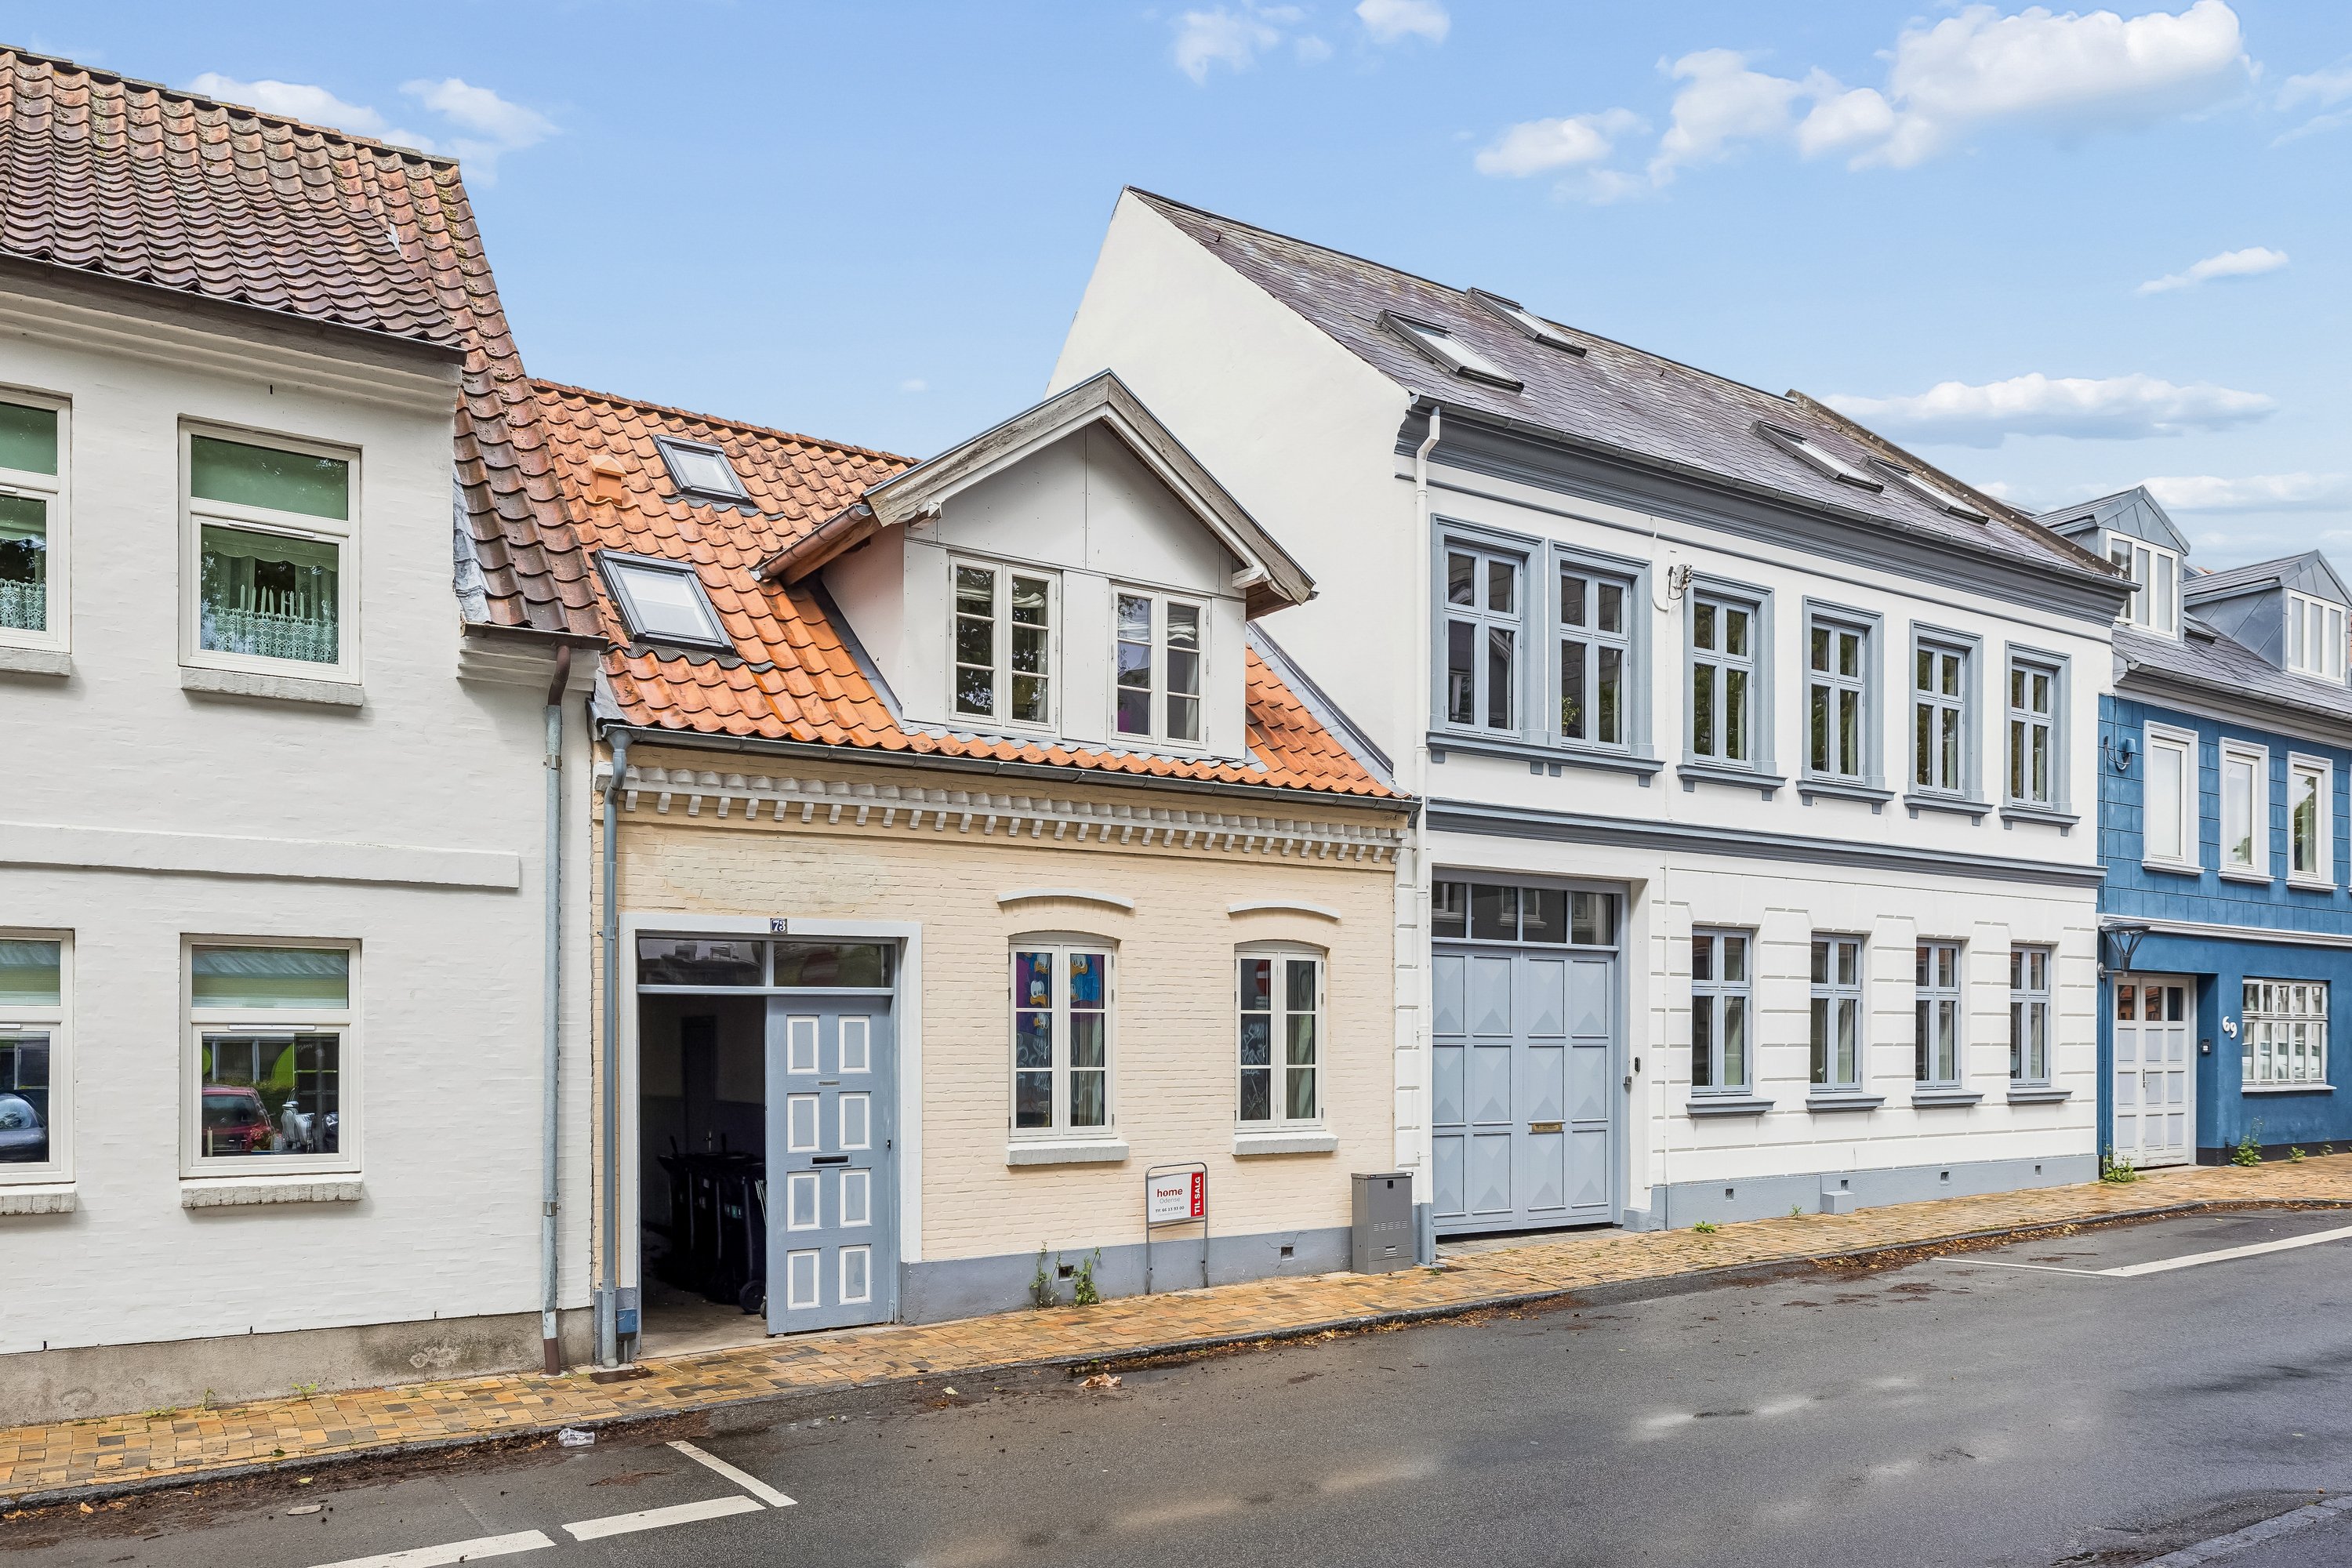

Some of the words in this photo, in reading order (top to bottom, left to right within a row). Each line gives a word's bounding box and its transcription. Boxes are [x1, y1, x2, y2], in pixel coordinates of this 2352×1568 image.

[772, 920, 786, 931] 73
[2222, 1015, 2238, 1039] 69
[1156, 1189, 1183, 1197] home
